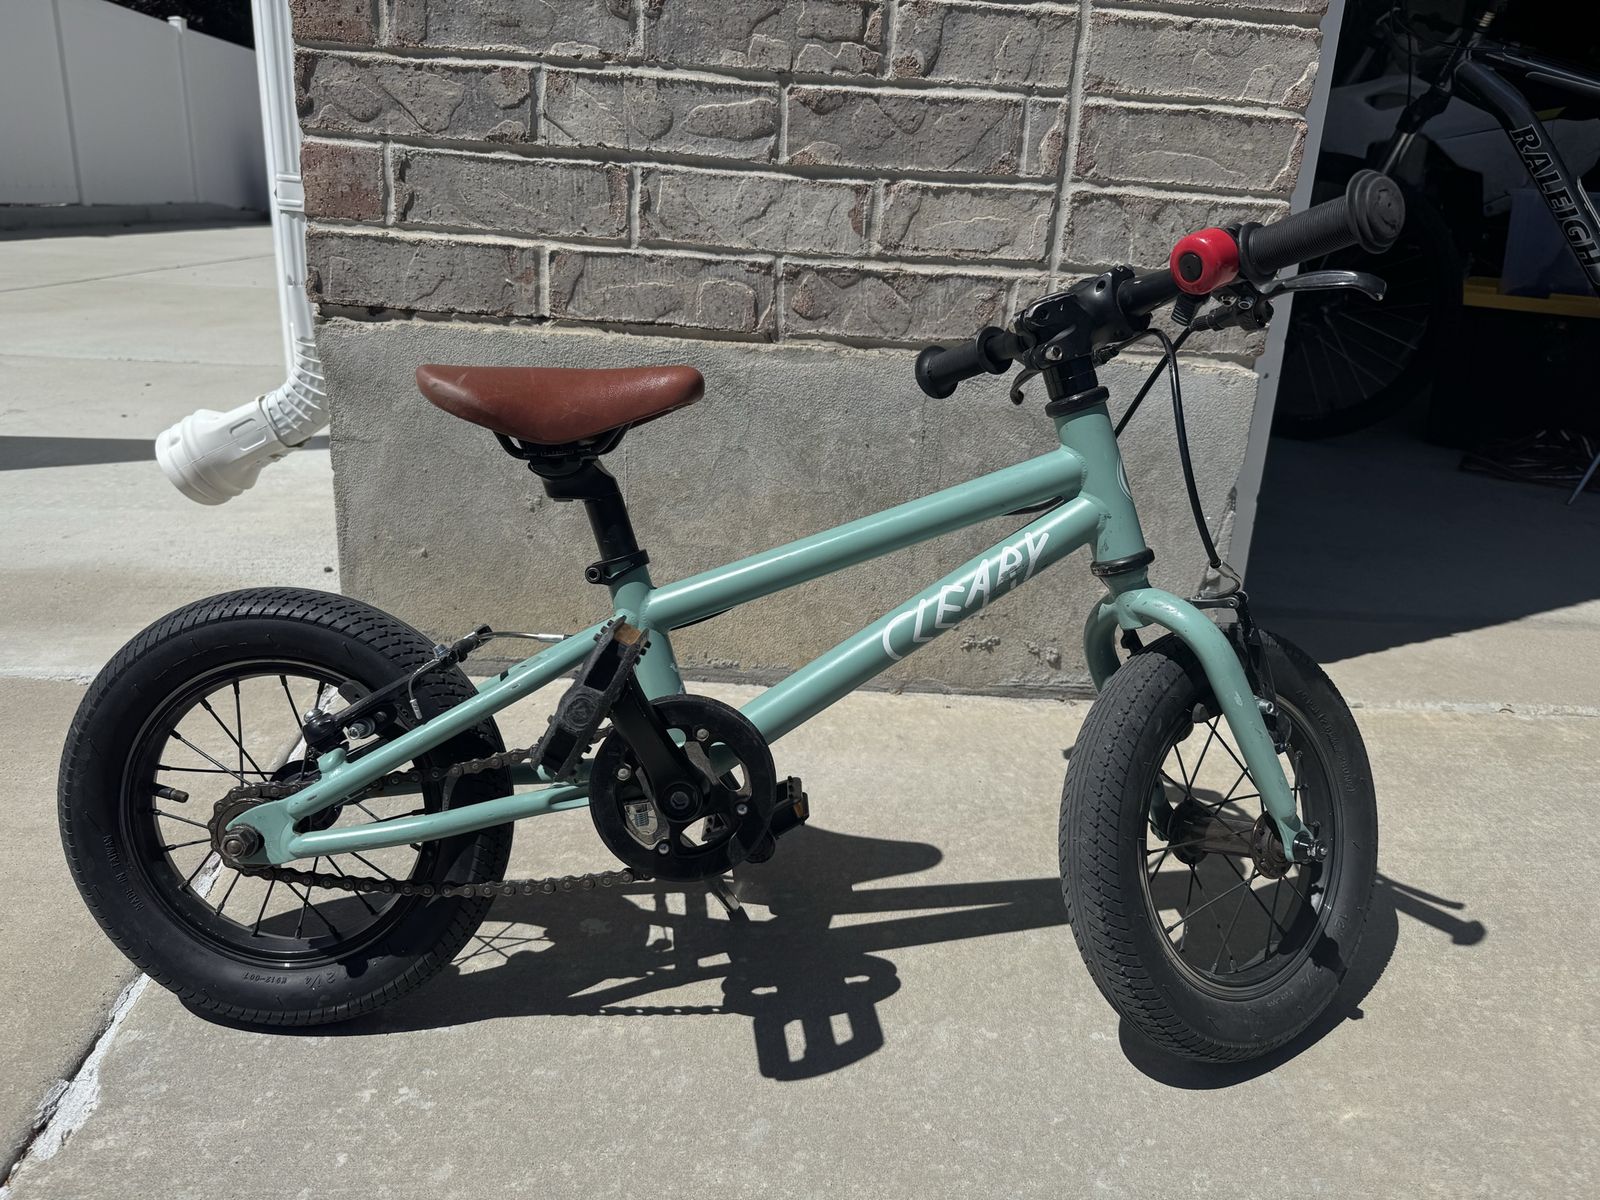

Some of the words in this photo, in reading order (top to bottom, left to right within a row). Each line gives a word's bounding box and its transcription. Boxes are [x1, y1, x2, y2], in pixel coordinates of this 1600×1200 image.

[1509, 124, 1600, 267] RALEIGH
[882, 532, 1050, 661] CLEARY
[103, 833, 120, 868] TAIWAN
[115, 871, 128, 884] IN
[126, 888, 145, 912] MADE
